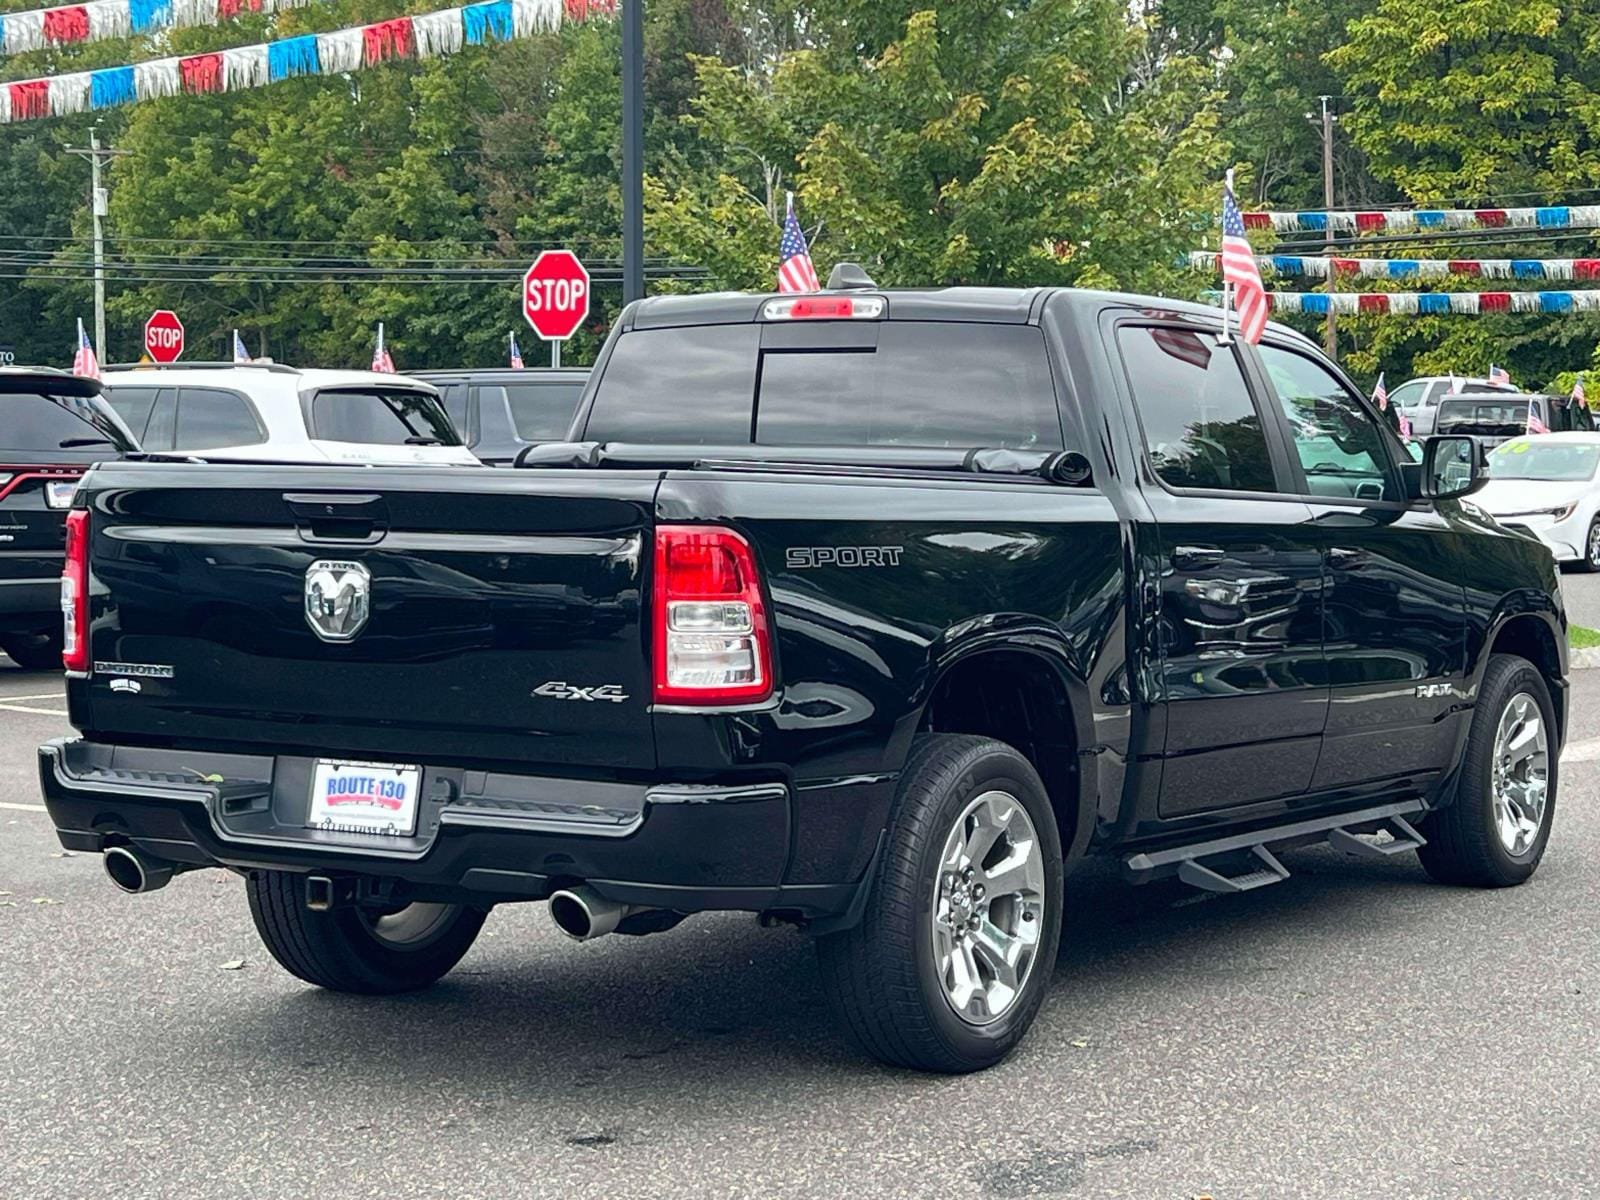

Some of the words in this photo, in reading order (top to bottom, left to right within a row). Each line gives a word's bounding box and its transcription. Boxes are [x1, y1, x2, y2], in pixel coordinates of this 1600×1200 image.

[528, 278, 585, 311] STOP
[148, 327, 181, 349] STOP
[786, 546, 904, 568] SPORT
[327, 777, 376, 796] ROUTE
[378, 780, 406, 800] 130
